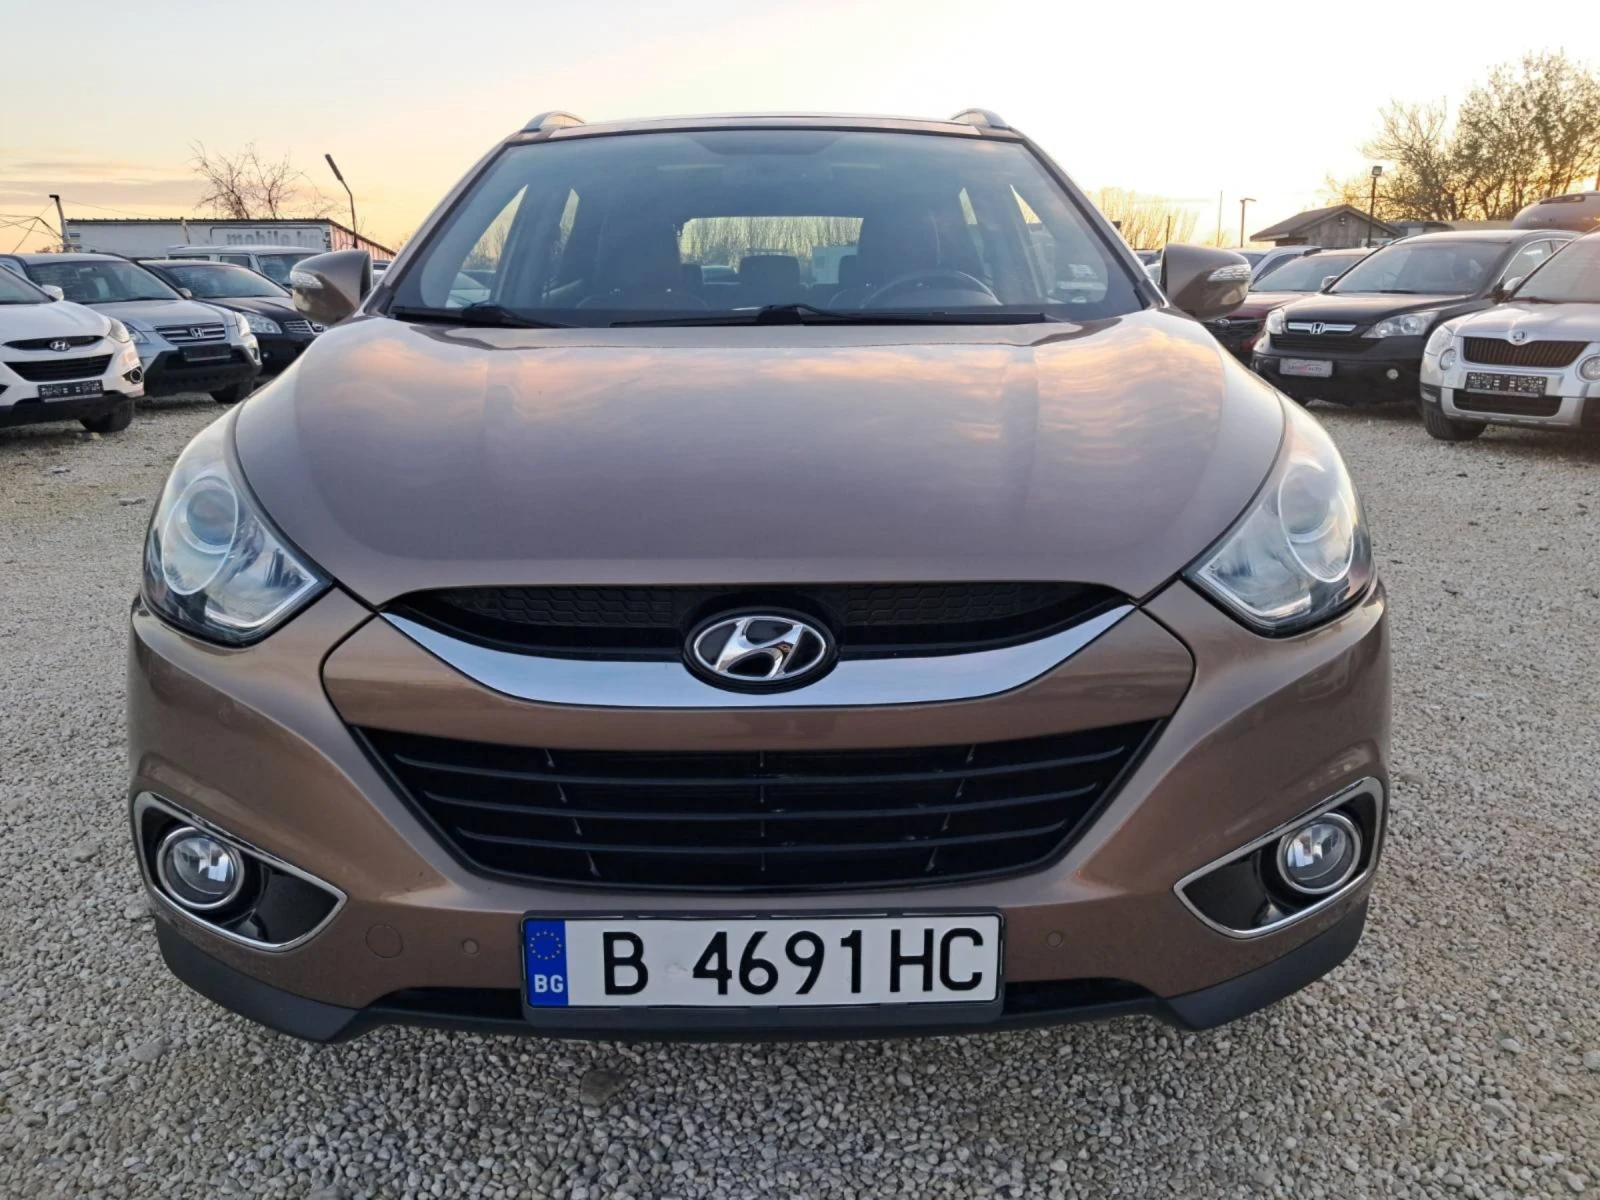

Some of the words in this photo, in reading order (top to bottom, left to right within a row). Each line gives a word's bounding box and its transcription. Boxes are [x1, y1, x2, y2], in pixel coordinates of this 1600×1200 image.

[226, 230, 318, 247] mobilebg
[602, 931, 649, 996] B
[692, 930, 862, 995] 4691
[889, 928, 984, 993] HC
[533, 974, 564, 993] BG
